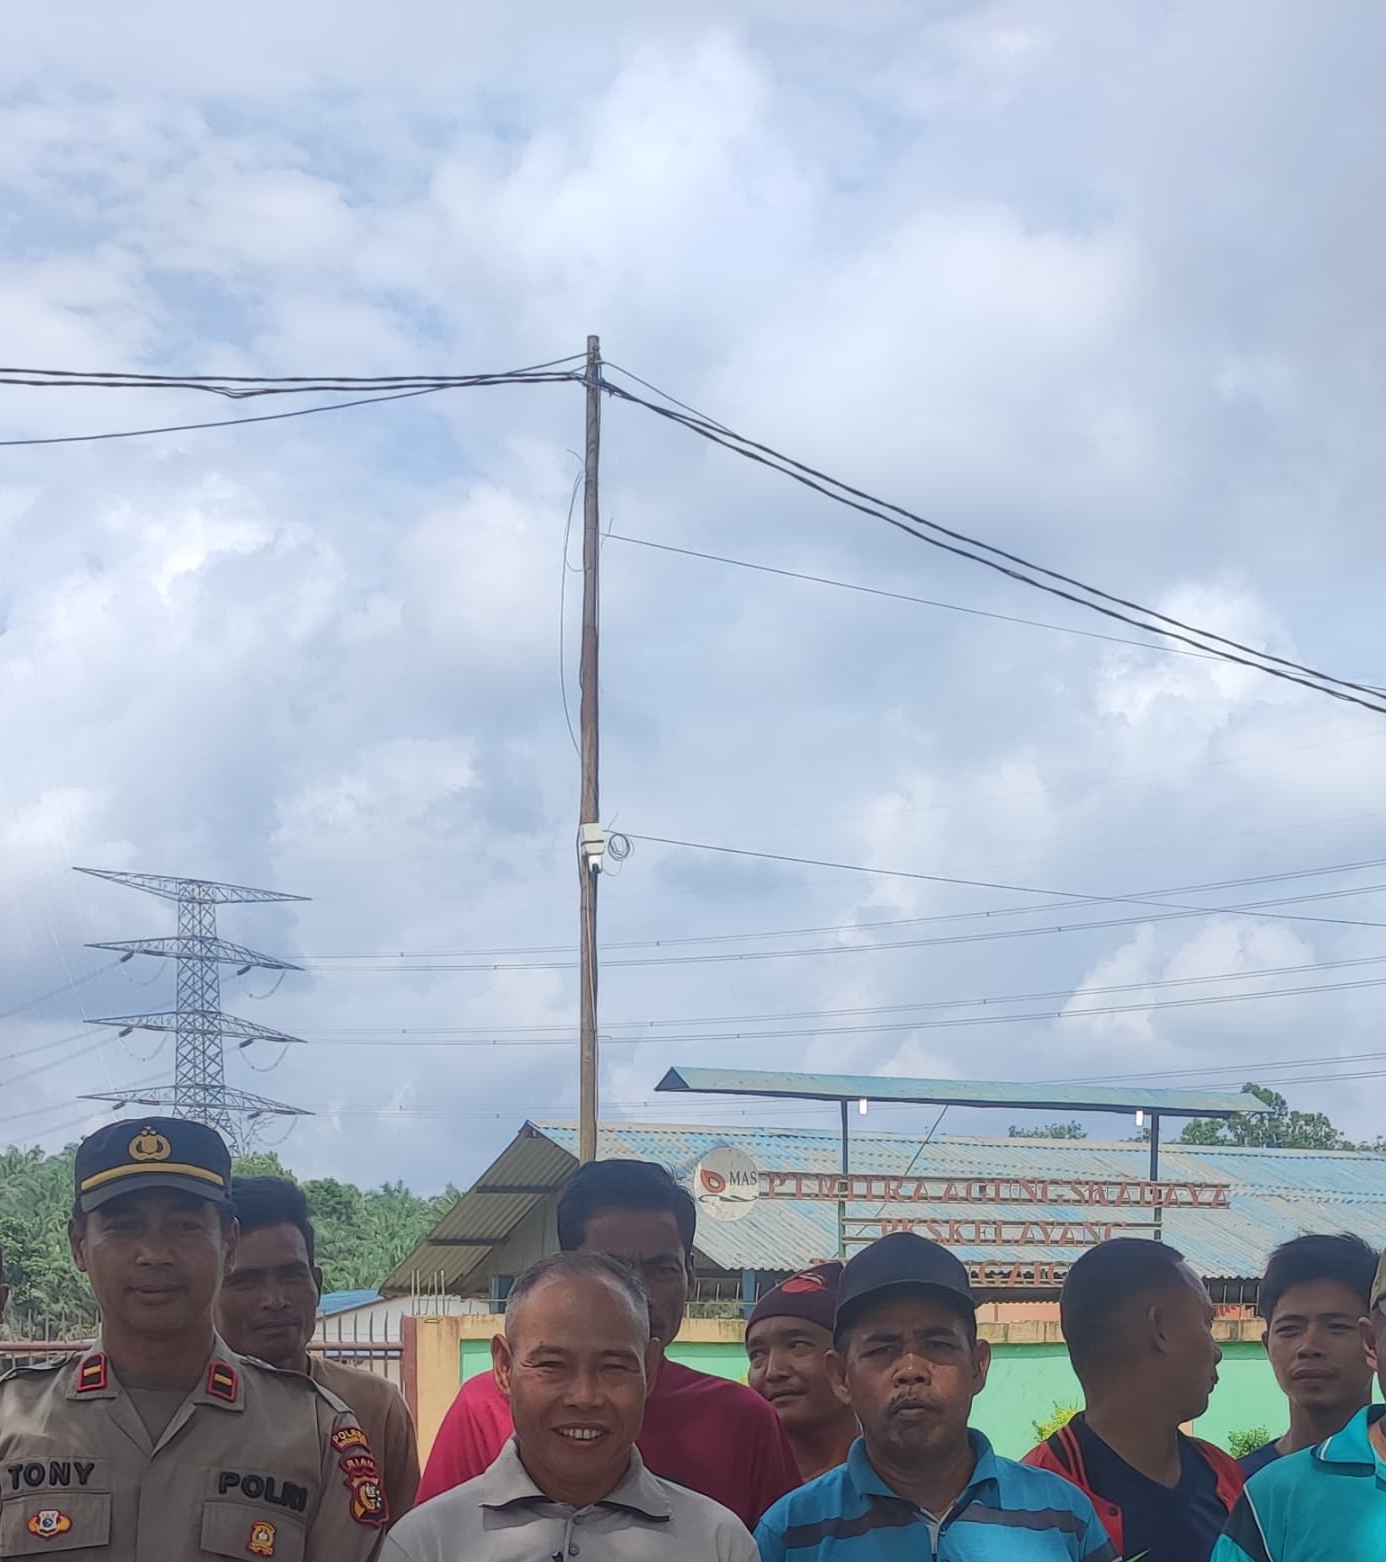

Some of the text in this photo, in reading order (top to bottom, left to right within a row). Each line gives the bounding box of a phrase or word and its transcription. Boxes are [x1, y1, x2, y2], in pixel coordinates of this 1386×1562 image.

[729, 1169, 757, 1187] MAS
[8, 1460, 95, 1490] TONY
[218, 1471, 308, 1512] POLRI
